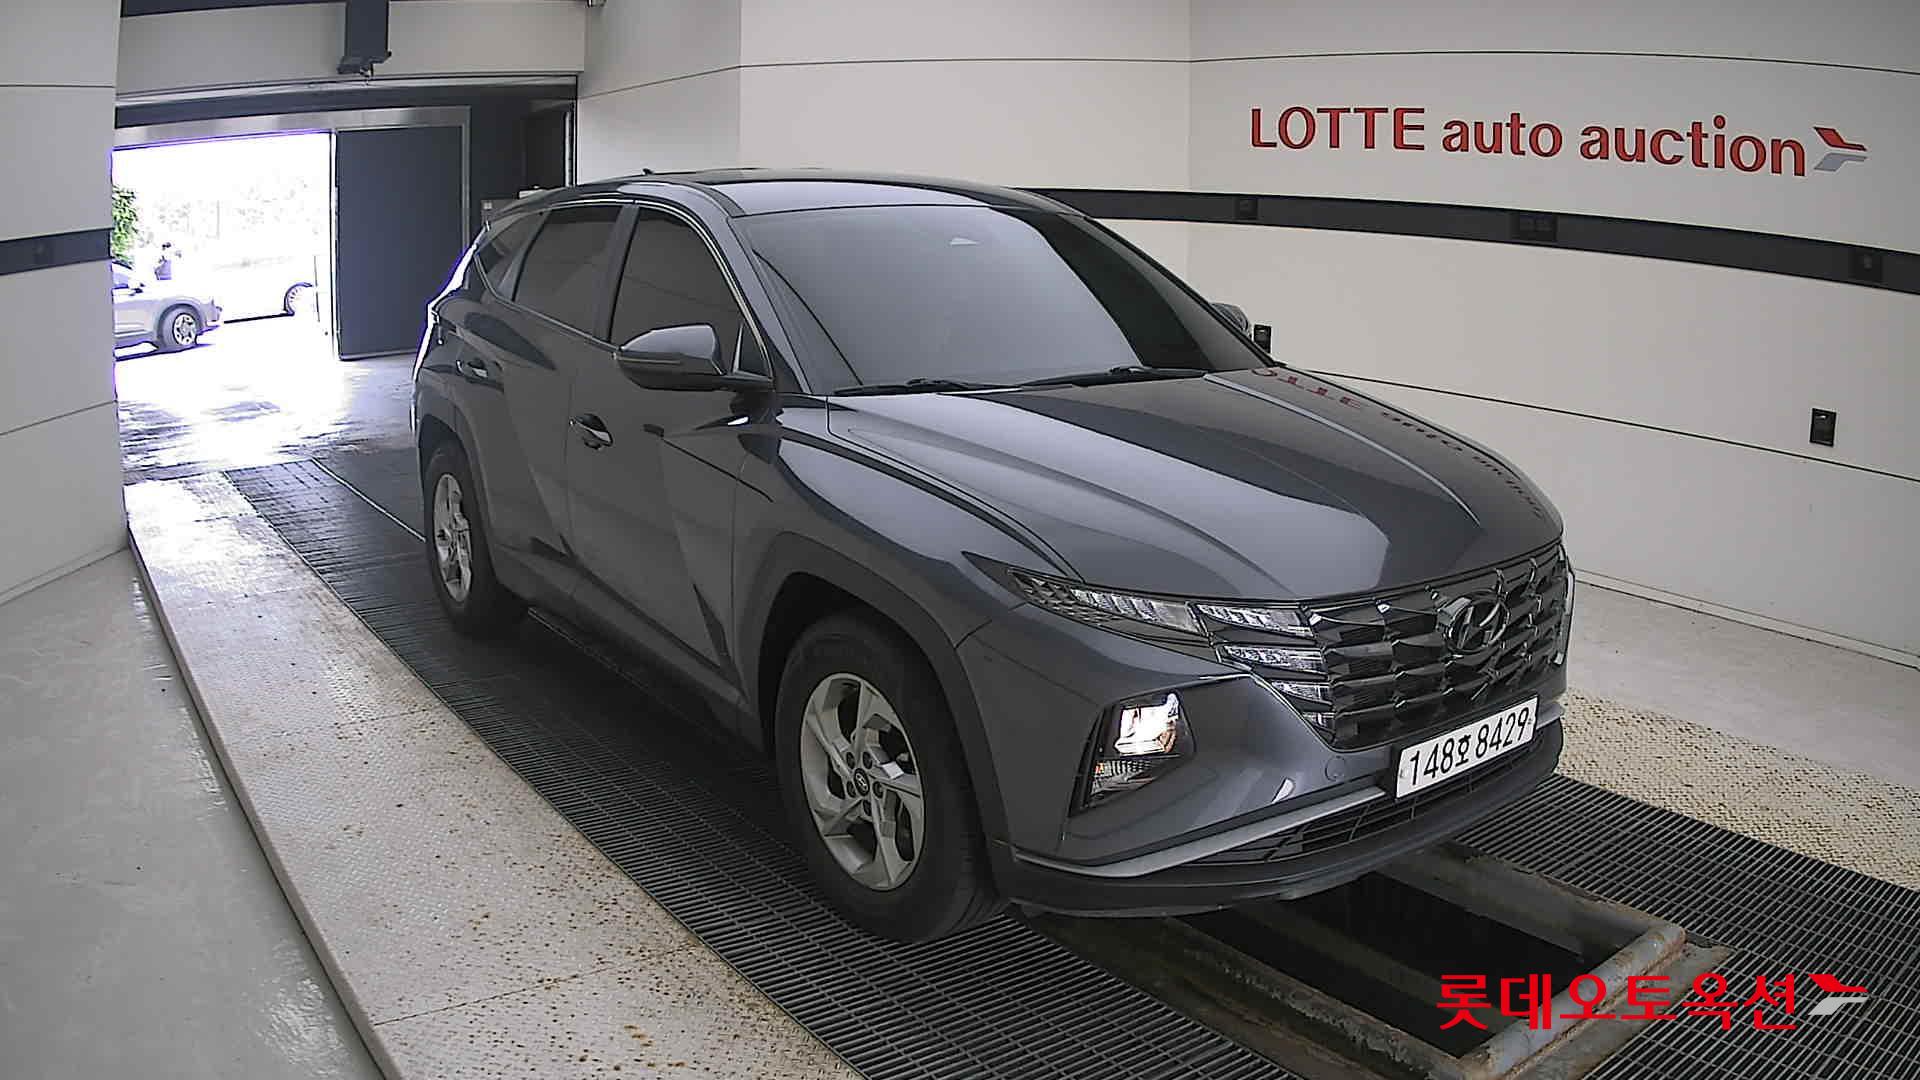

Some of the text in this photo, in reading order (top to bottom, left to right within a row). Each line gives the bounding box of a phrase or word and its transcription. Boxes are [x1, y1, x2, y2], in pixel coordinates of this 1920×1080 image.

[1251, 107, 1806, 177] LOTTE auto auction
